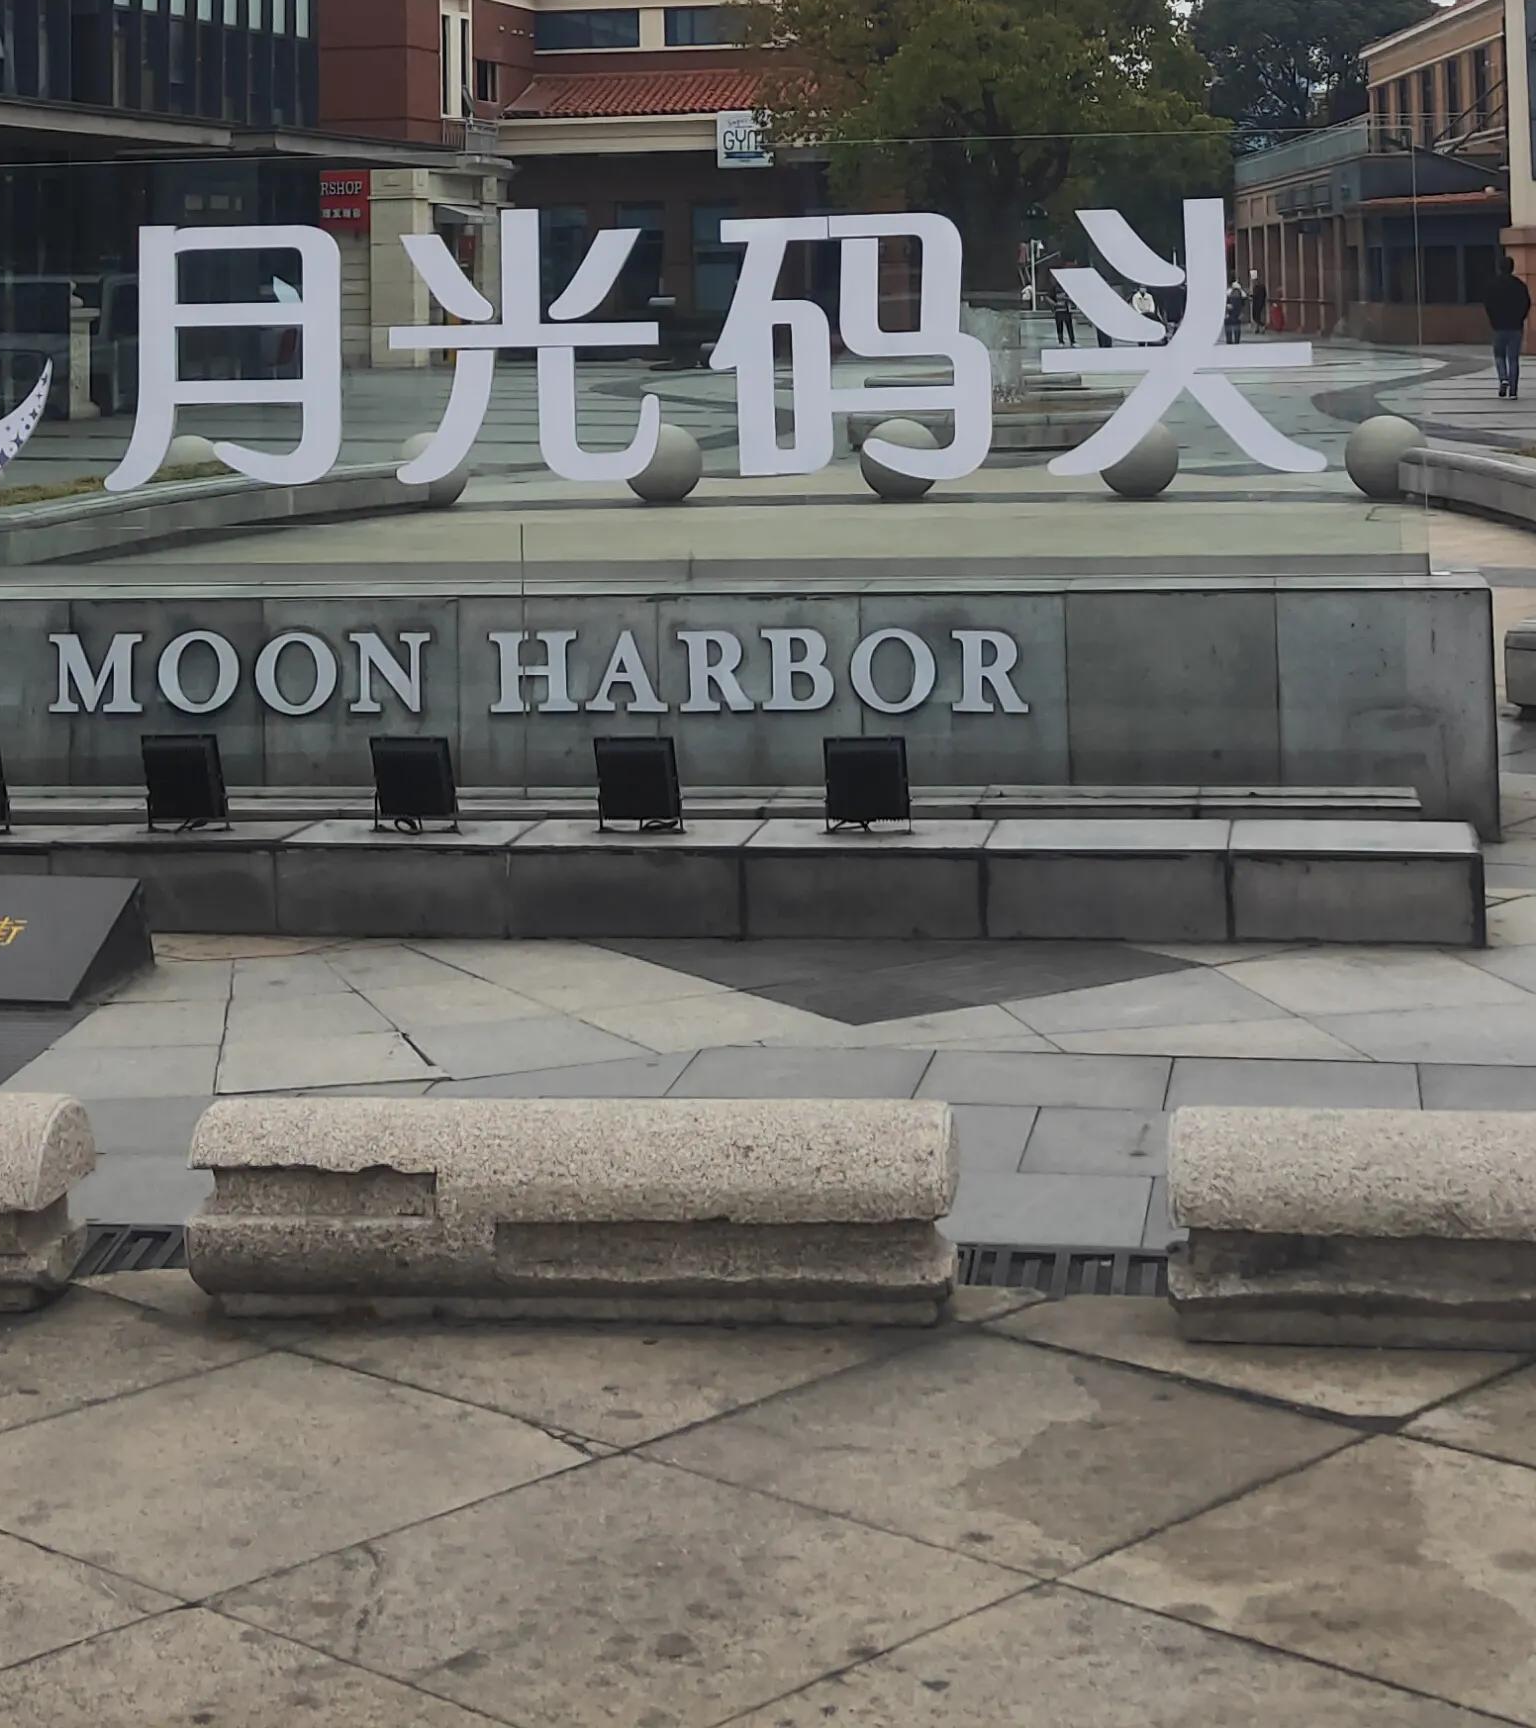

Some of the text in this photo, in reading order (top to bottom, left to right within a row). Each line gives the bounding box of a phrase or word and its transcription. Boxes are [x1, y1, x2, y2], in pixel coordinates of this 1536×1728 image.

[104, 198, 1327, 492] 月光码头
[48, 627, 1030, 716] MOON HARBOR
